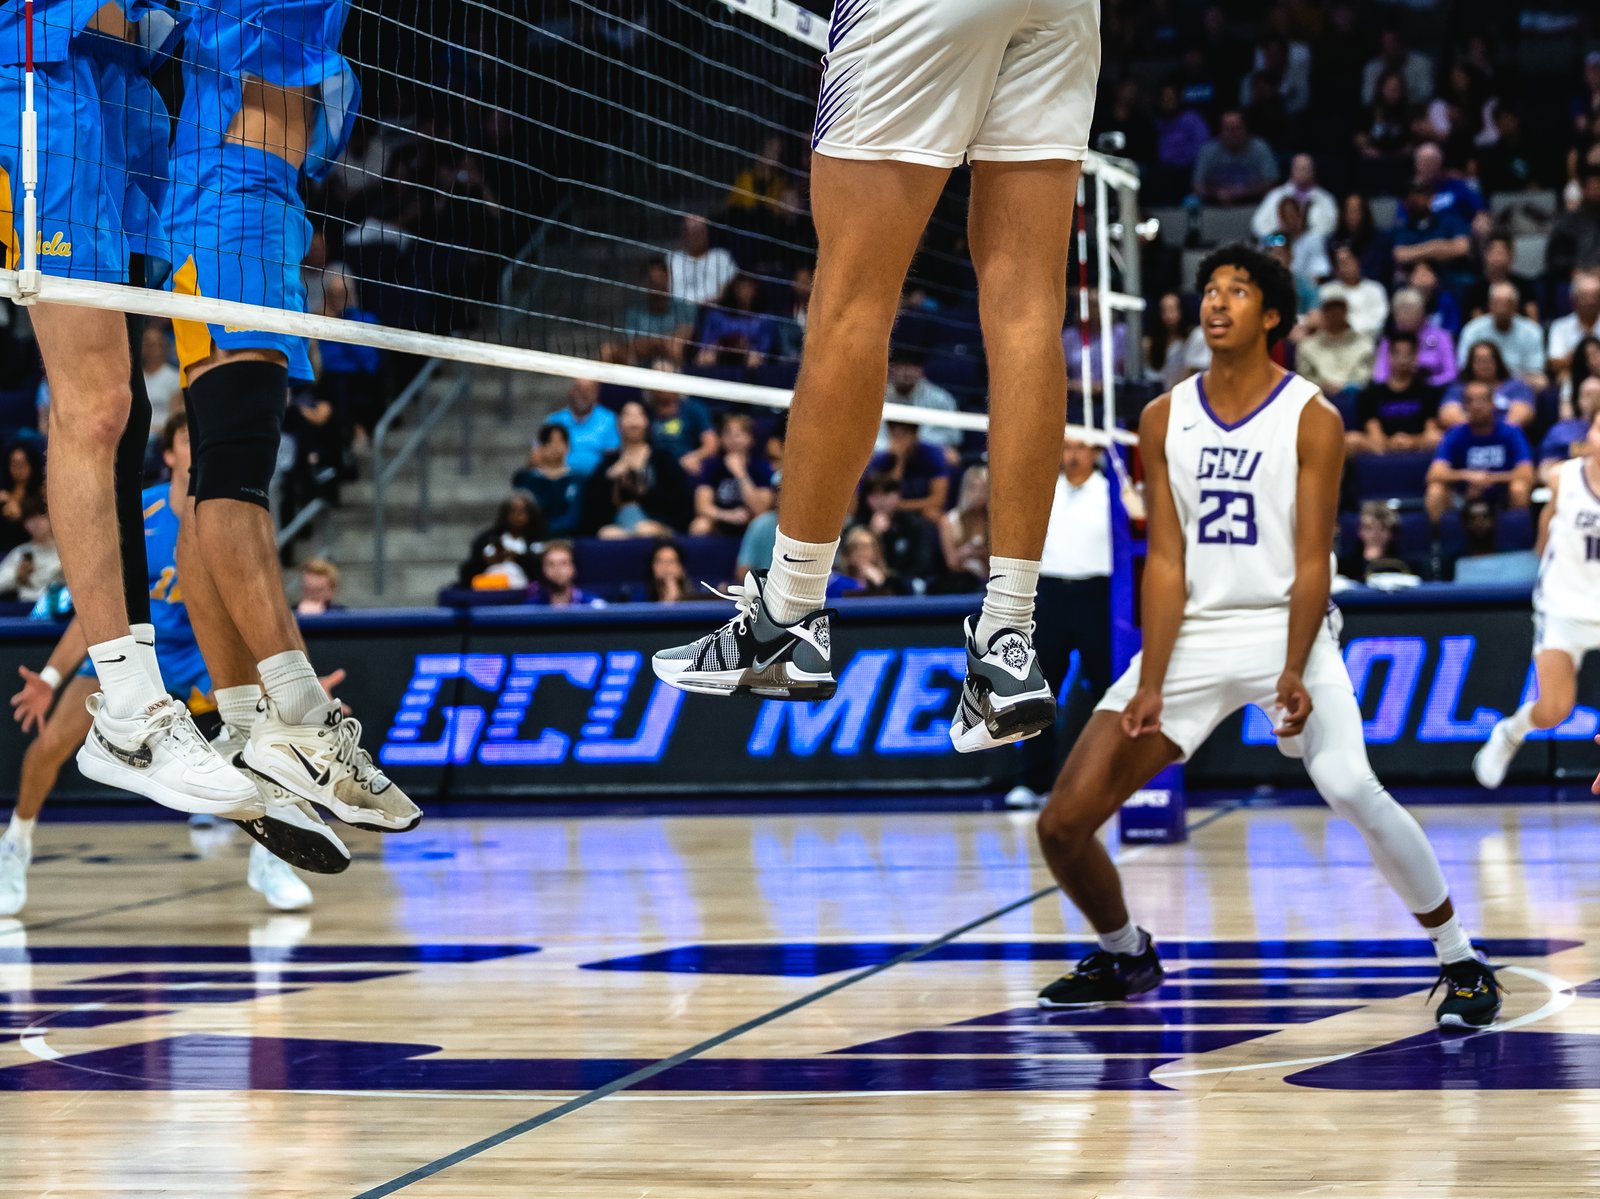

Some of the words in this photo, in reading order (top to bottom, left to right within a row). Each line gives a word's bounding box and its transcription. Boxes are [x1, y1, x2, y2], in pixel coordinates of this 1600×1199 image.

[1196, 447, 1263, 481] GCU
[1197, 490, 1258, 545] 23
[379, 651, 688, 765] GCU
